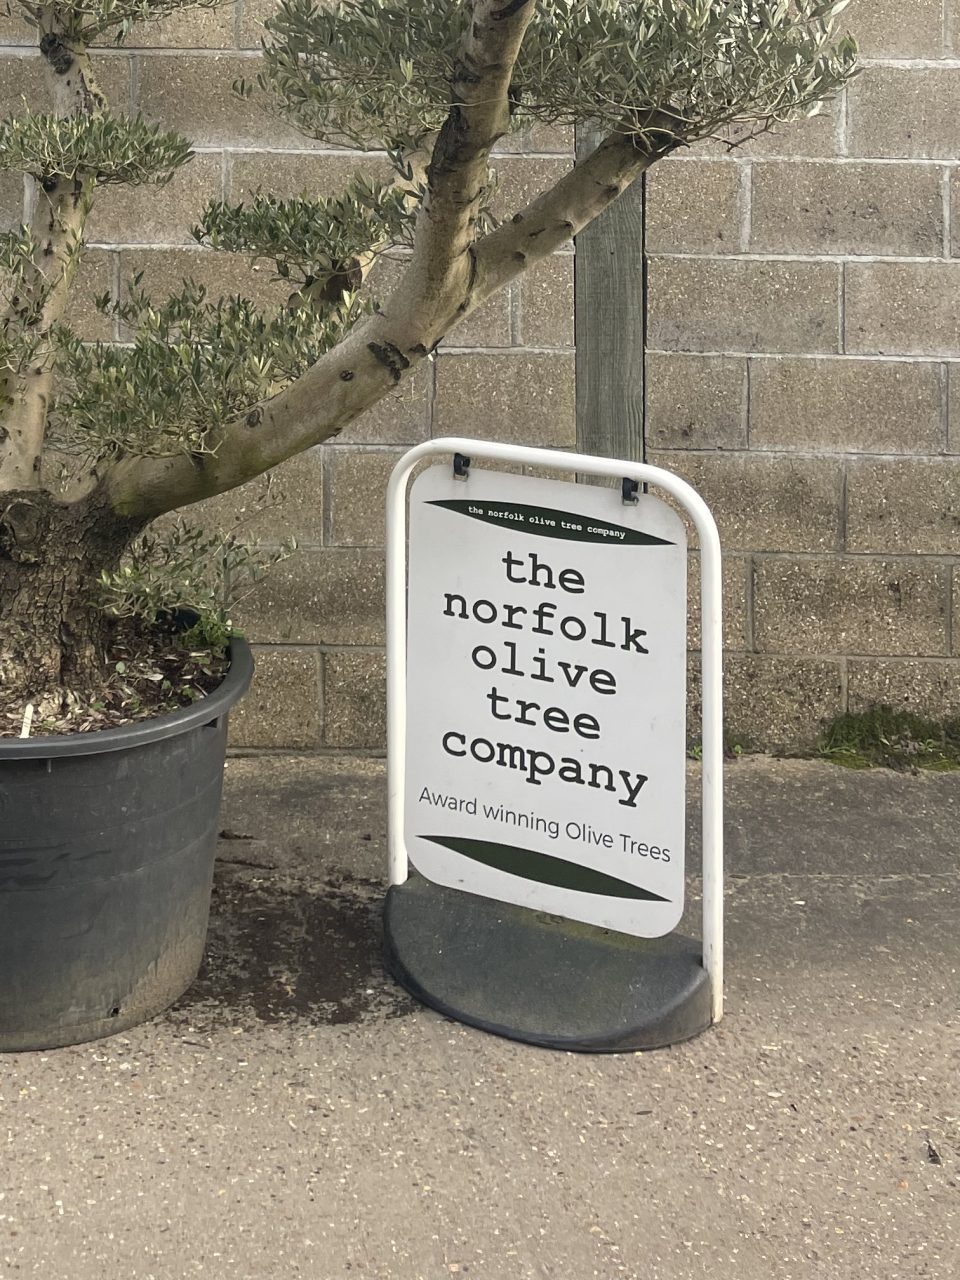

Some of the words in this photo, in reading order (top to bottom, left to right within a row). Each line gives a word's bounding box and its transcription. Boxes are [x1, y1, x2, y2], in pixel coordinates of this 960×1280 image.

[468, 505, 484, 515] the
[488, 510, 525, 522] norfolk
[529, 515, 556, 527] olive
[561, 521, 583, 531] tree
[587, 526, 626, 540] company
[501, 550, 585, 594] the
[443, 593, 649, 655] norfolk
[471, 641, 617, 695] olive
[486, 686, 601, 740] tree
[442, 731, 649, 808] company
[418, 786, 477, 815] Award
[483, 805, 560, 840] winning
[565, 822, 614, 848] Olive
[619, 833, 672, 863] Trees
